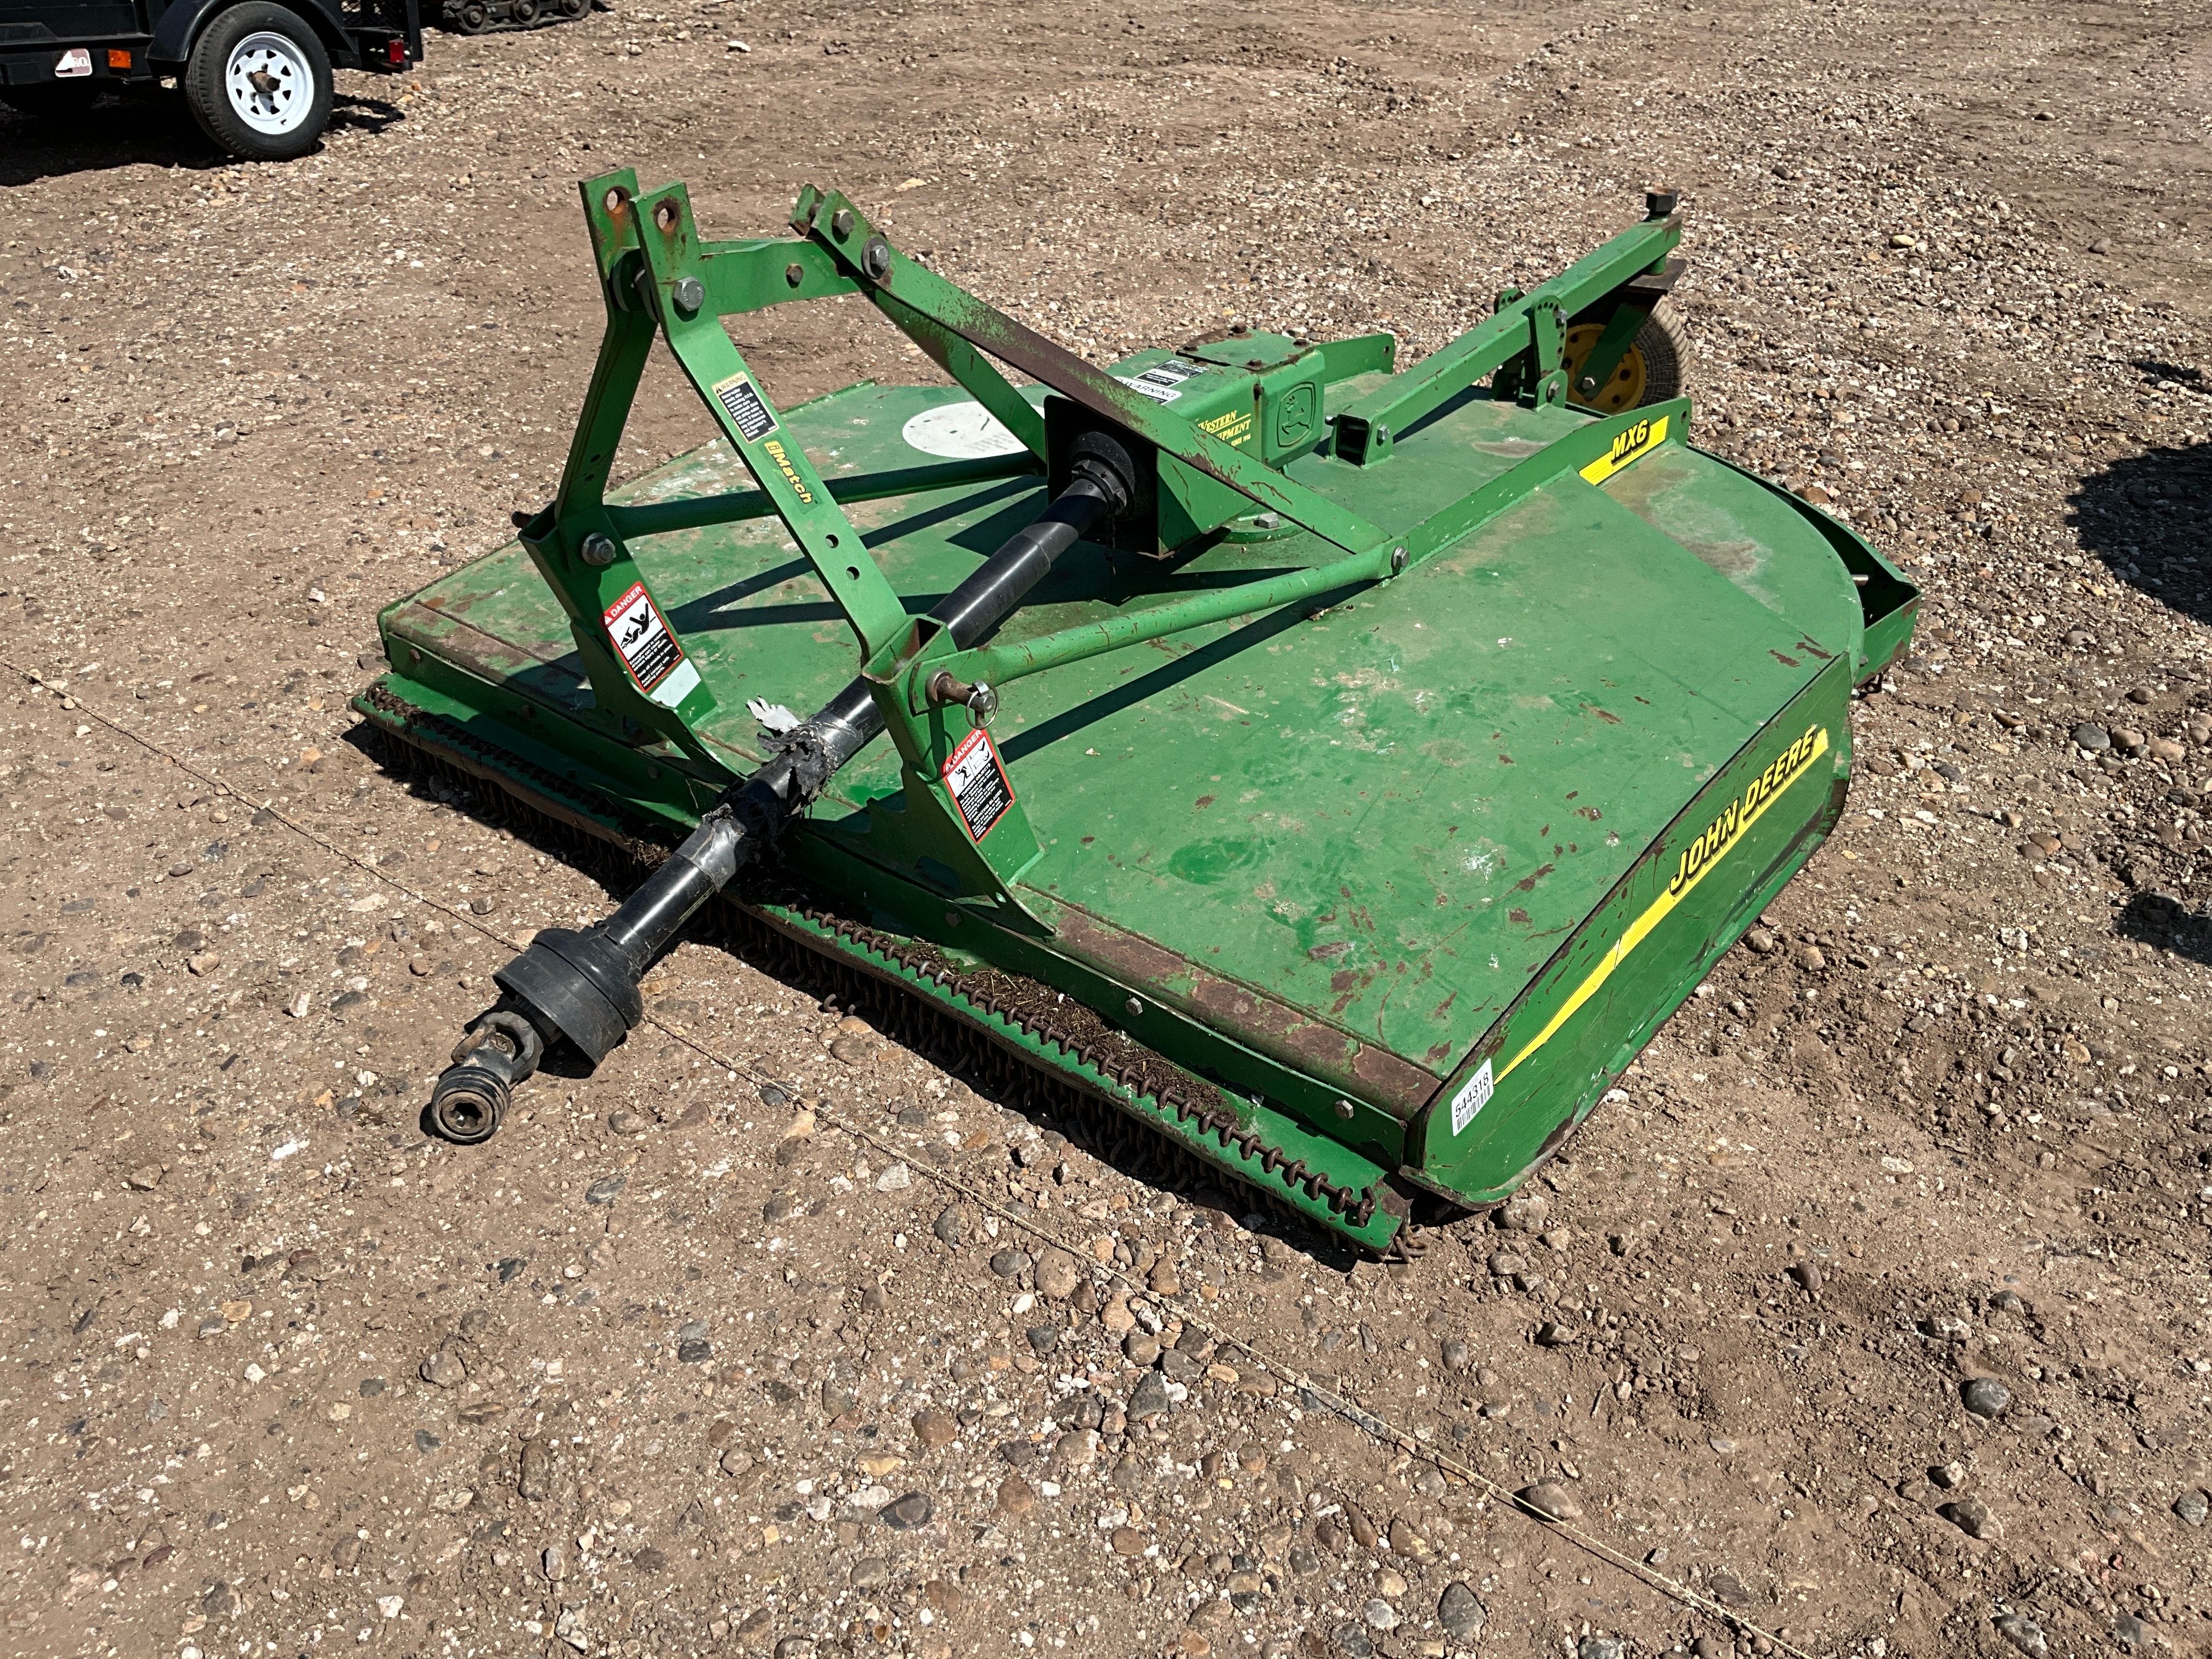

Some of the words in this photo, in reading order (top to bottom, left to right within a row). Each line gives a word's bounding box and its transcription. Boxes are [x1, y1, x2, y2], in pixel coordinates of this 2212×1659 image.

[720, 374, 746, 390] WARNING
[1610, 418, 1651, 466] MX6
[610, 585, 642, 617] DANGER
[952, 730, 982, 765] DANGER
[1669, 797, 1741, 896] JOHN
[1742, 723, 1818, 823] DEERE
[1455, 1072, 1489, 1118] 544318
